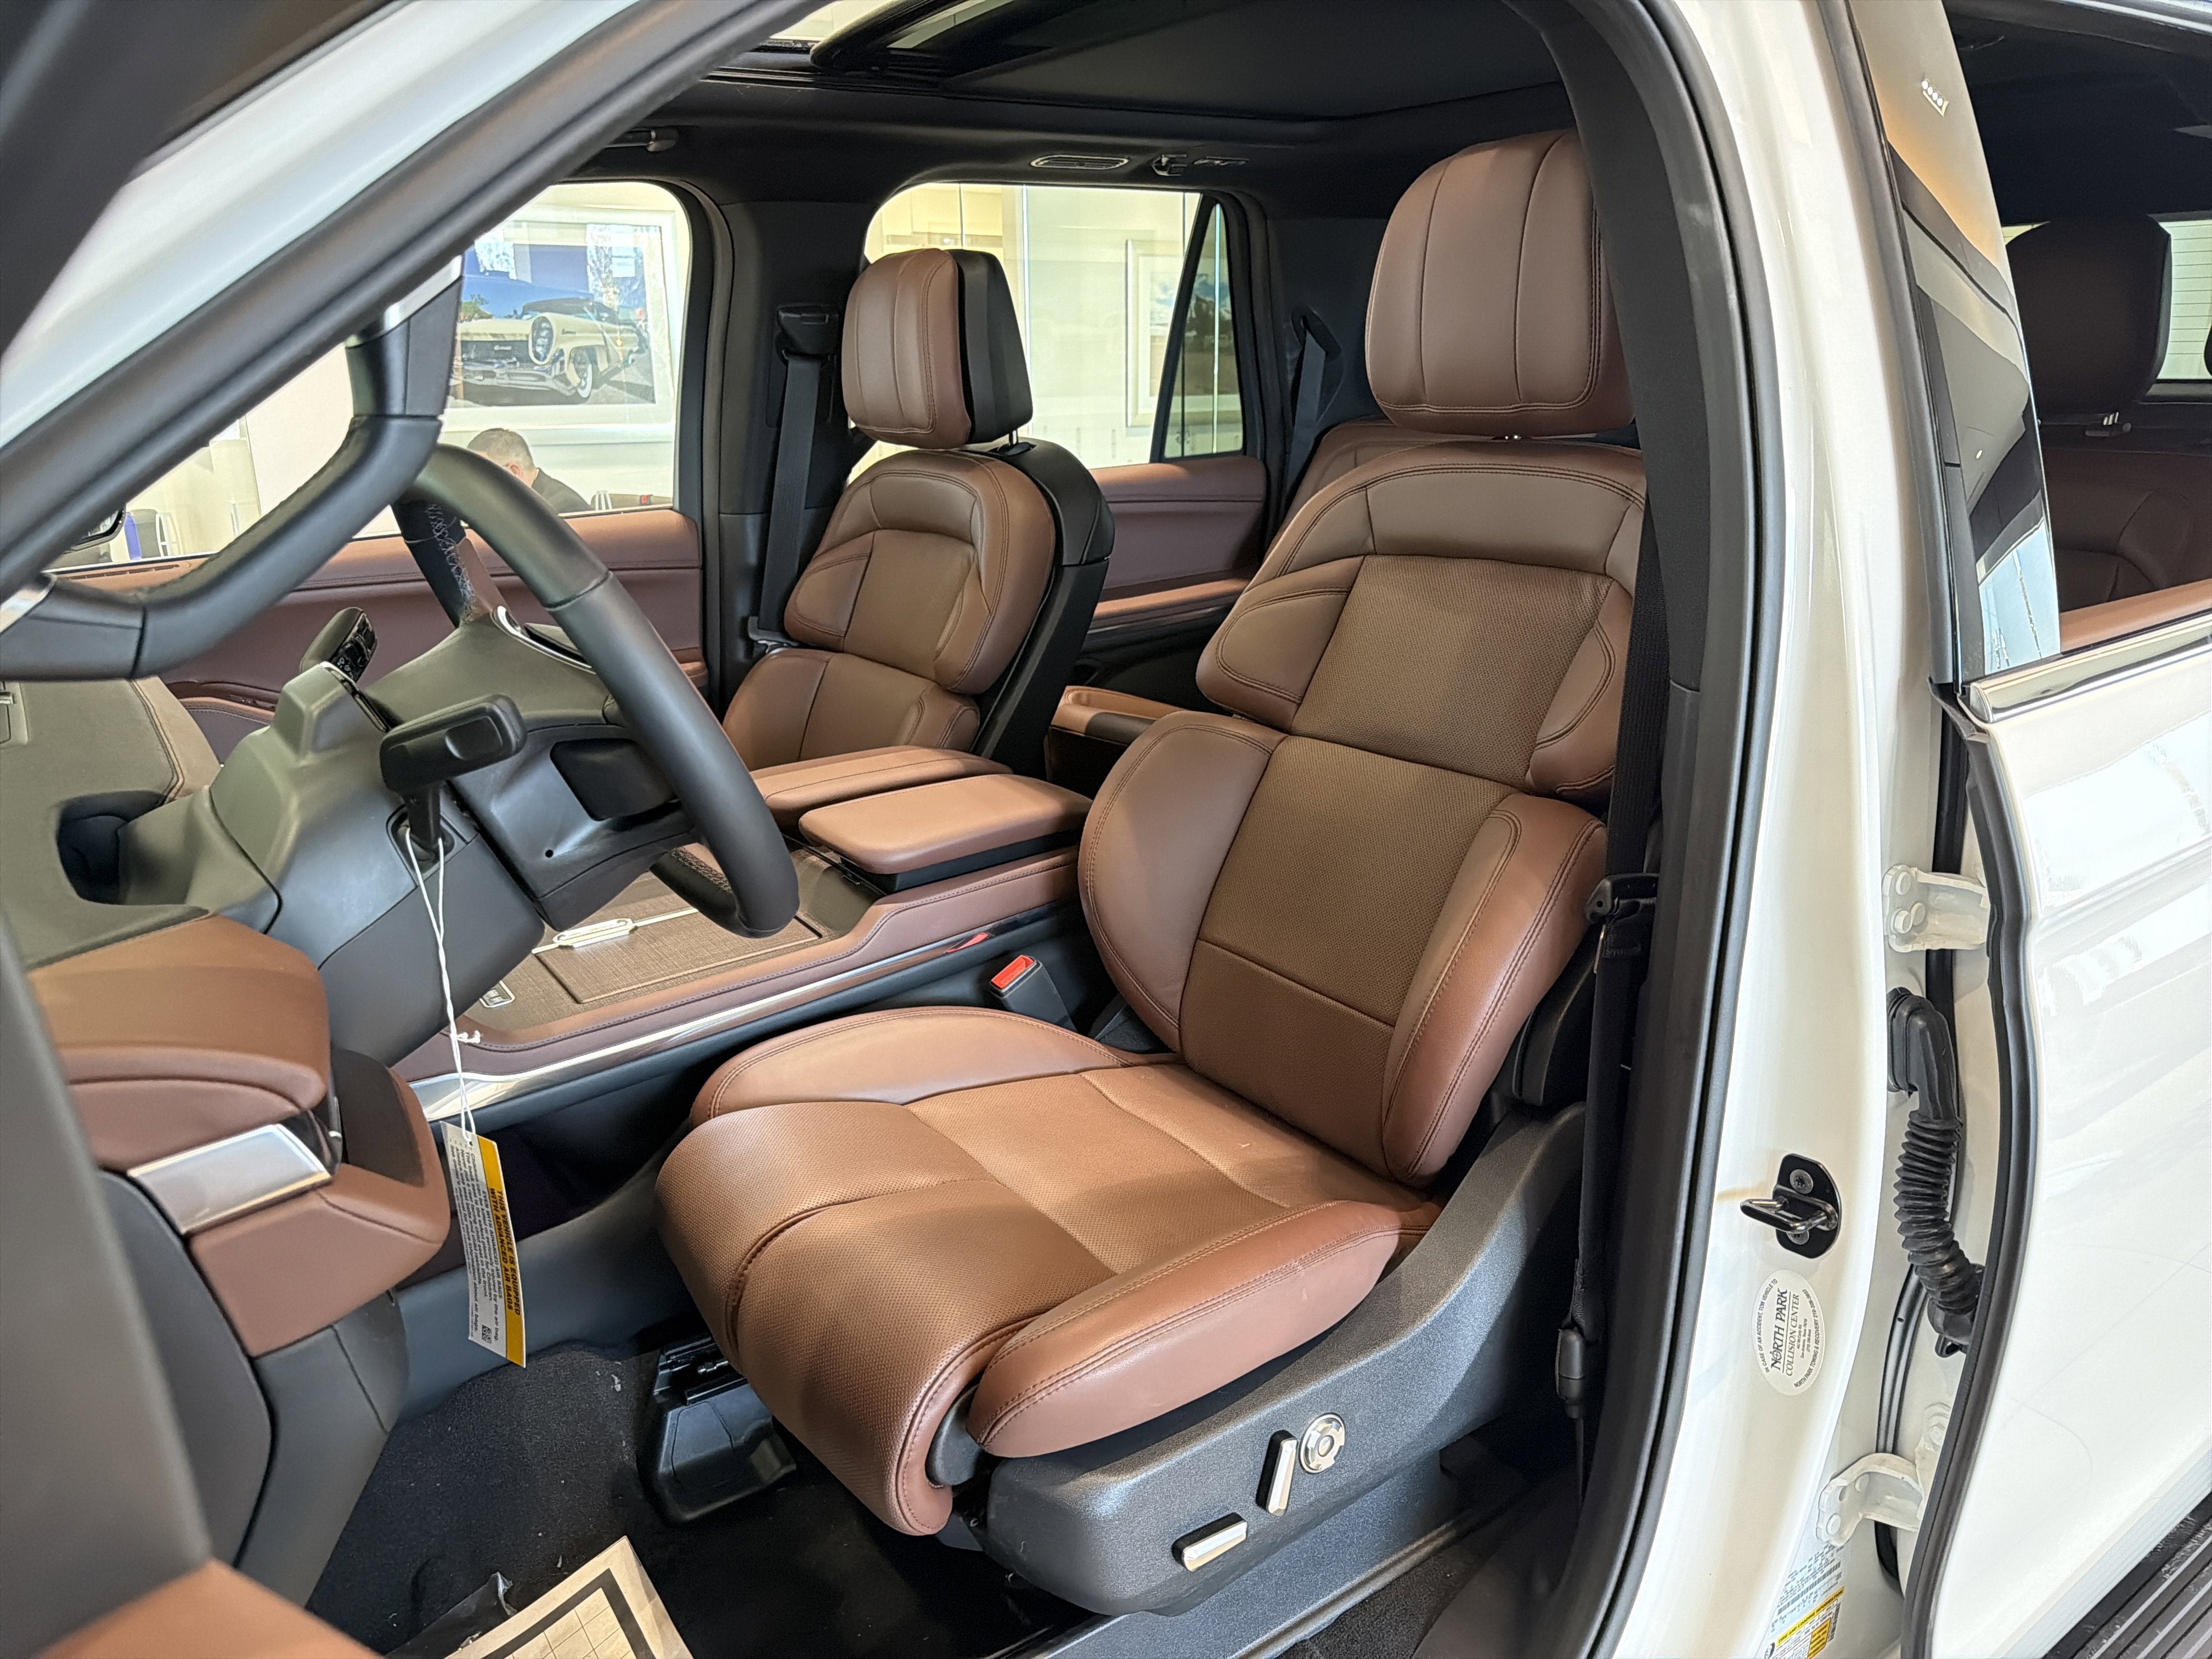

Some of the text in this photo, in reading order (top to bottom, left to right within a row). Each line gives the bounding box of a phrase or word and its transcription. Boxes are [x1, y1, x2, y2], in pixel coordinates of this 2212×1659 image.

[490, 1188, 499, 1212] WITH
[479, 1198, 483, 1206] be
[486, 1236, 494, 1267] seriously
[493, 1293, 497, 1302] by
[489, 1229, 499, 1265] ADVANCED
[494, 1213, 508, 1264] ADVANCED
[497, 1190, 521, 1316] THIS VEHICLE IS EQUIPPED
[1762, 1283, 1773, 1301] VEHICLE
[1770, 1288, 1787, 1371] NORTH PARK
[1785, 1294, 1799, 1376] COLLISION CENTER
[1759, 1352, 1767, 1366] CASE
[1793, 1377, 1807, 1388] NORTH
[1804, 1367, 1814, 1379] PARK
[1810, 1350, 1818, 1368] TOWING
